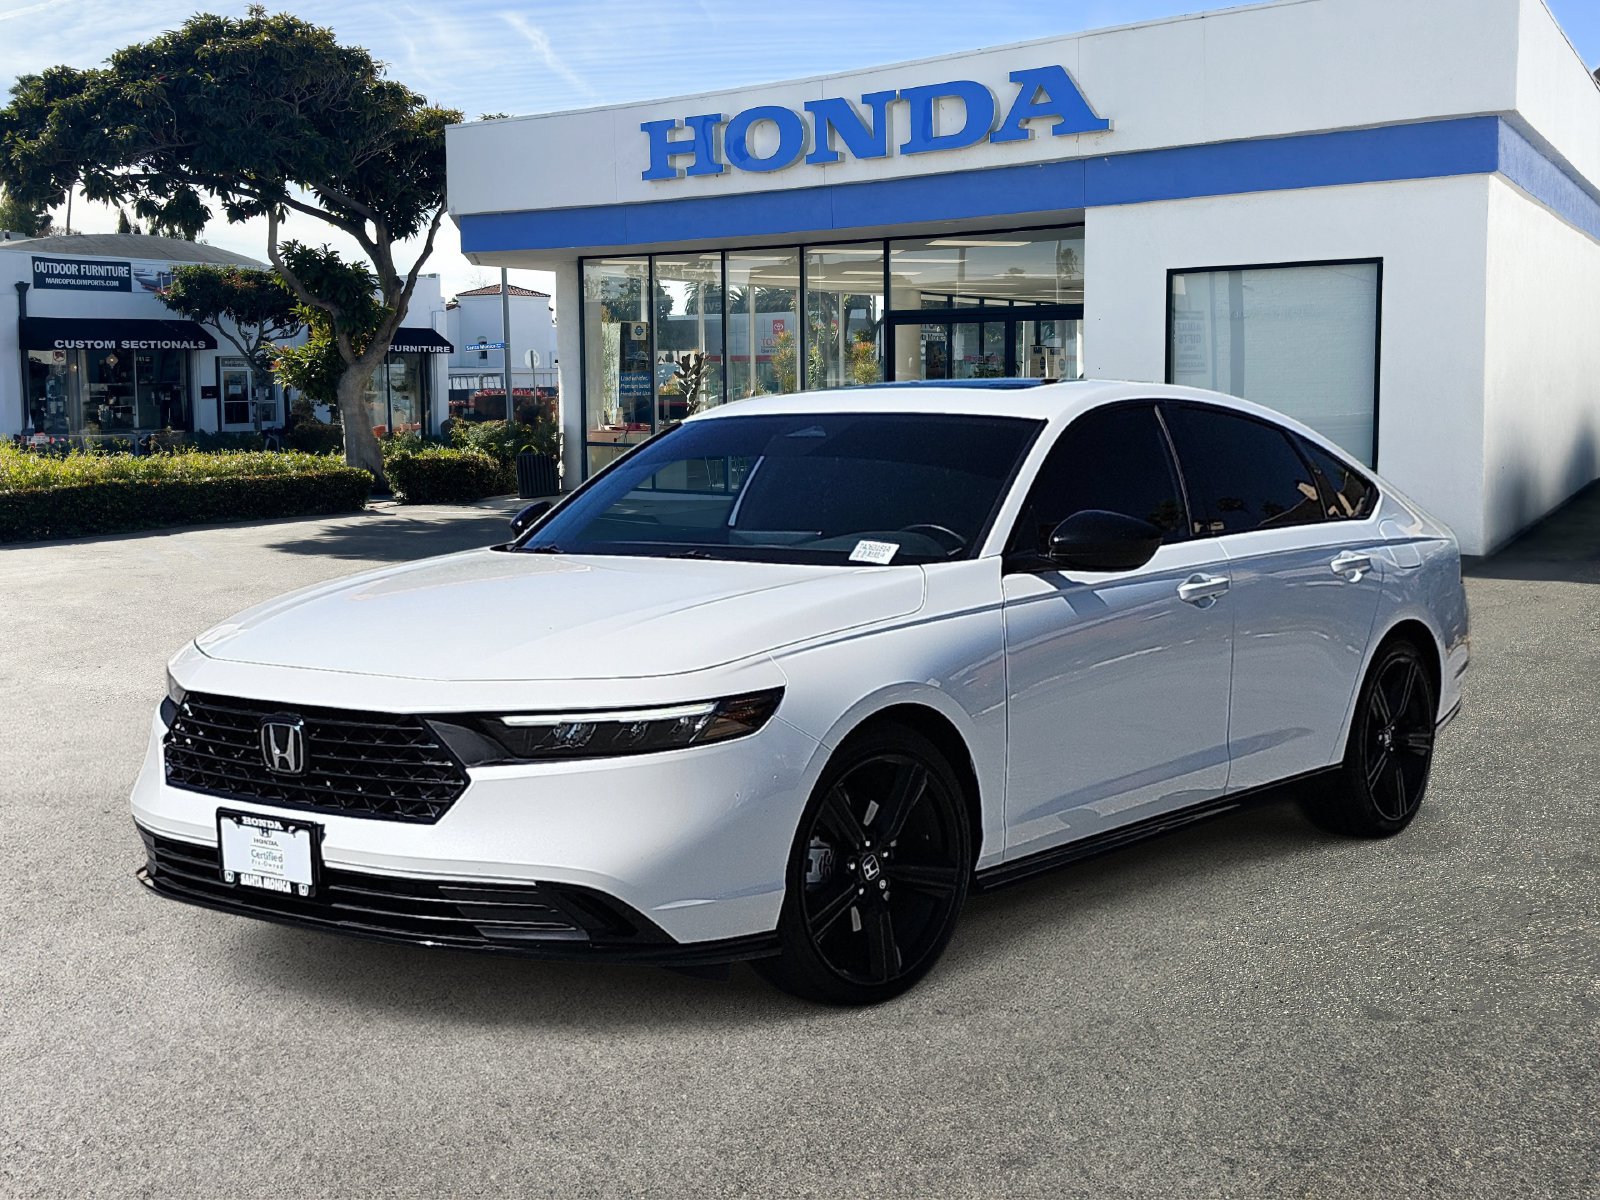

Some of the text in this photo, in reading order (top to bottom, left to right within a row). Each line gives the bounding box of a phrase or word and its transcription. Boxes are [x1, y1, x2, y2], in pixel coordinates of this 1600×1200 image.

[640, 64, 1112, 181] HONDA
[34, 261, 130, 278] OUTDOOR FURNITURE
[45, 277, 120, 288] MARCOPOLOIMPORTS.COM
[54, 339, 206, 349] CUSTOM SECTIONALS
[388, 344, 451, 353] FURNITURE
[242, 816, 284, 831] HONDA
[253, 837, 279, 848] HONDA
[251, 849, 283, 863] Certified
[251, 859, 284, 870] Pre-Owned
